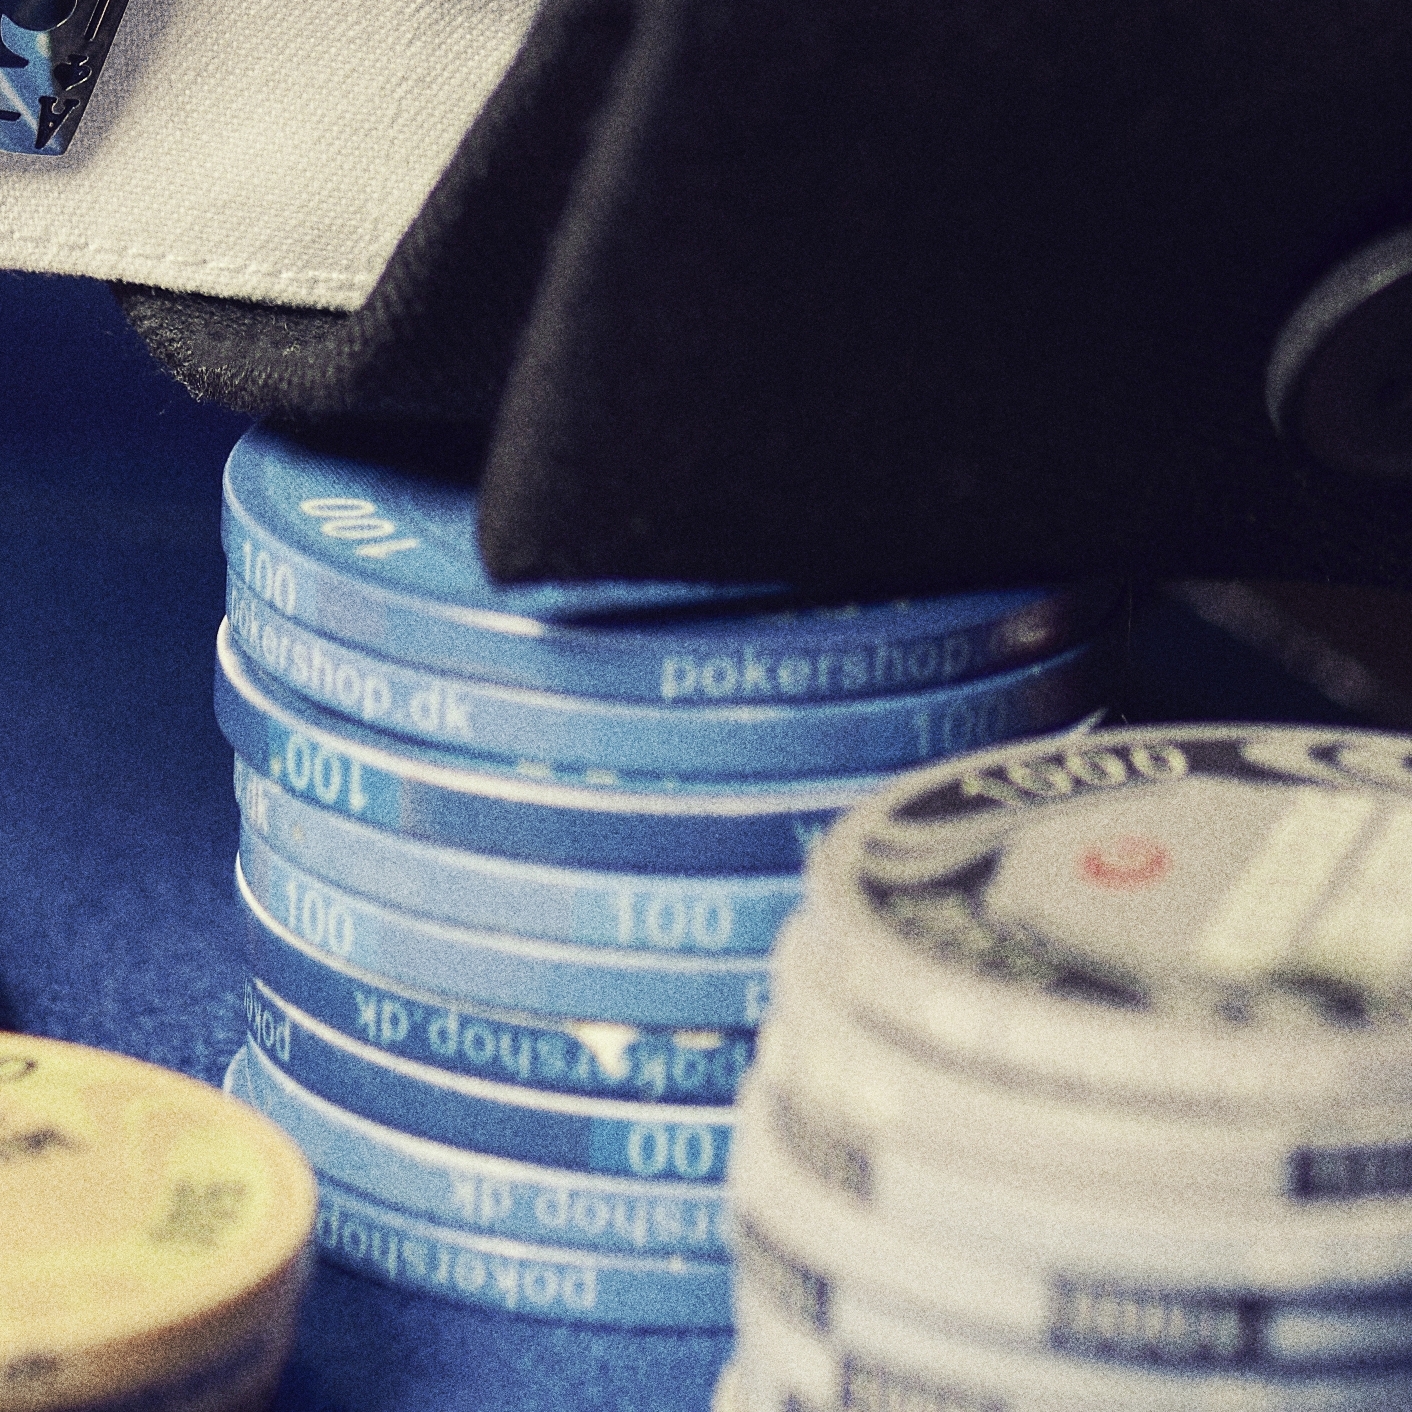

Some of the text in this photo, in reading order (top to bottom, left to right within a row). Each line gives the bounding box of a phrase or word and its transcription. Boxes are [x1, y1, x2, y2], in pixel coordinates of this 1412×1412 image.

[35, 96, 79, 149] A
[299, 497, 418, 558] 100
[243, 540, 296, 614] 100
[285, 880, 353, 955] 100
[612, 890, 733, 949] 100
[627, 1122, 712, 1175] 00
[450, 1180, 743, 1245] rshop.dk
